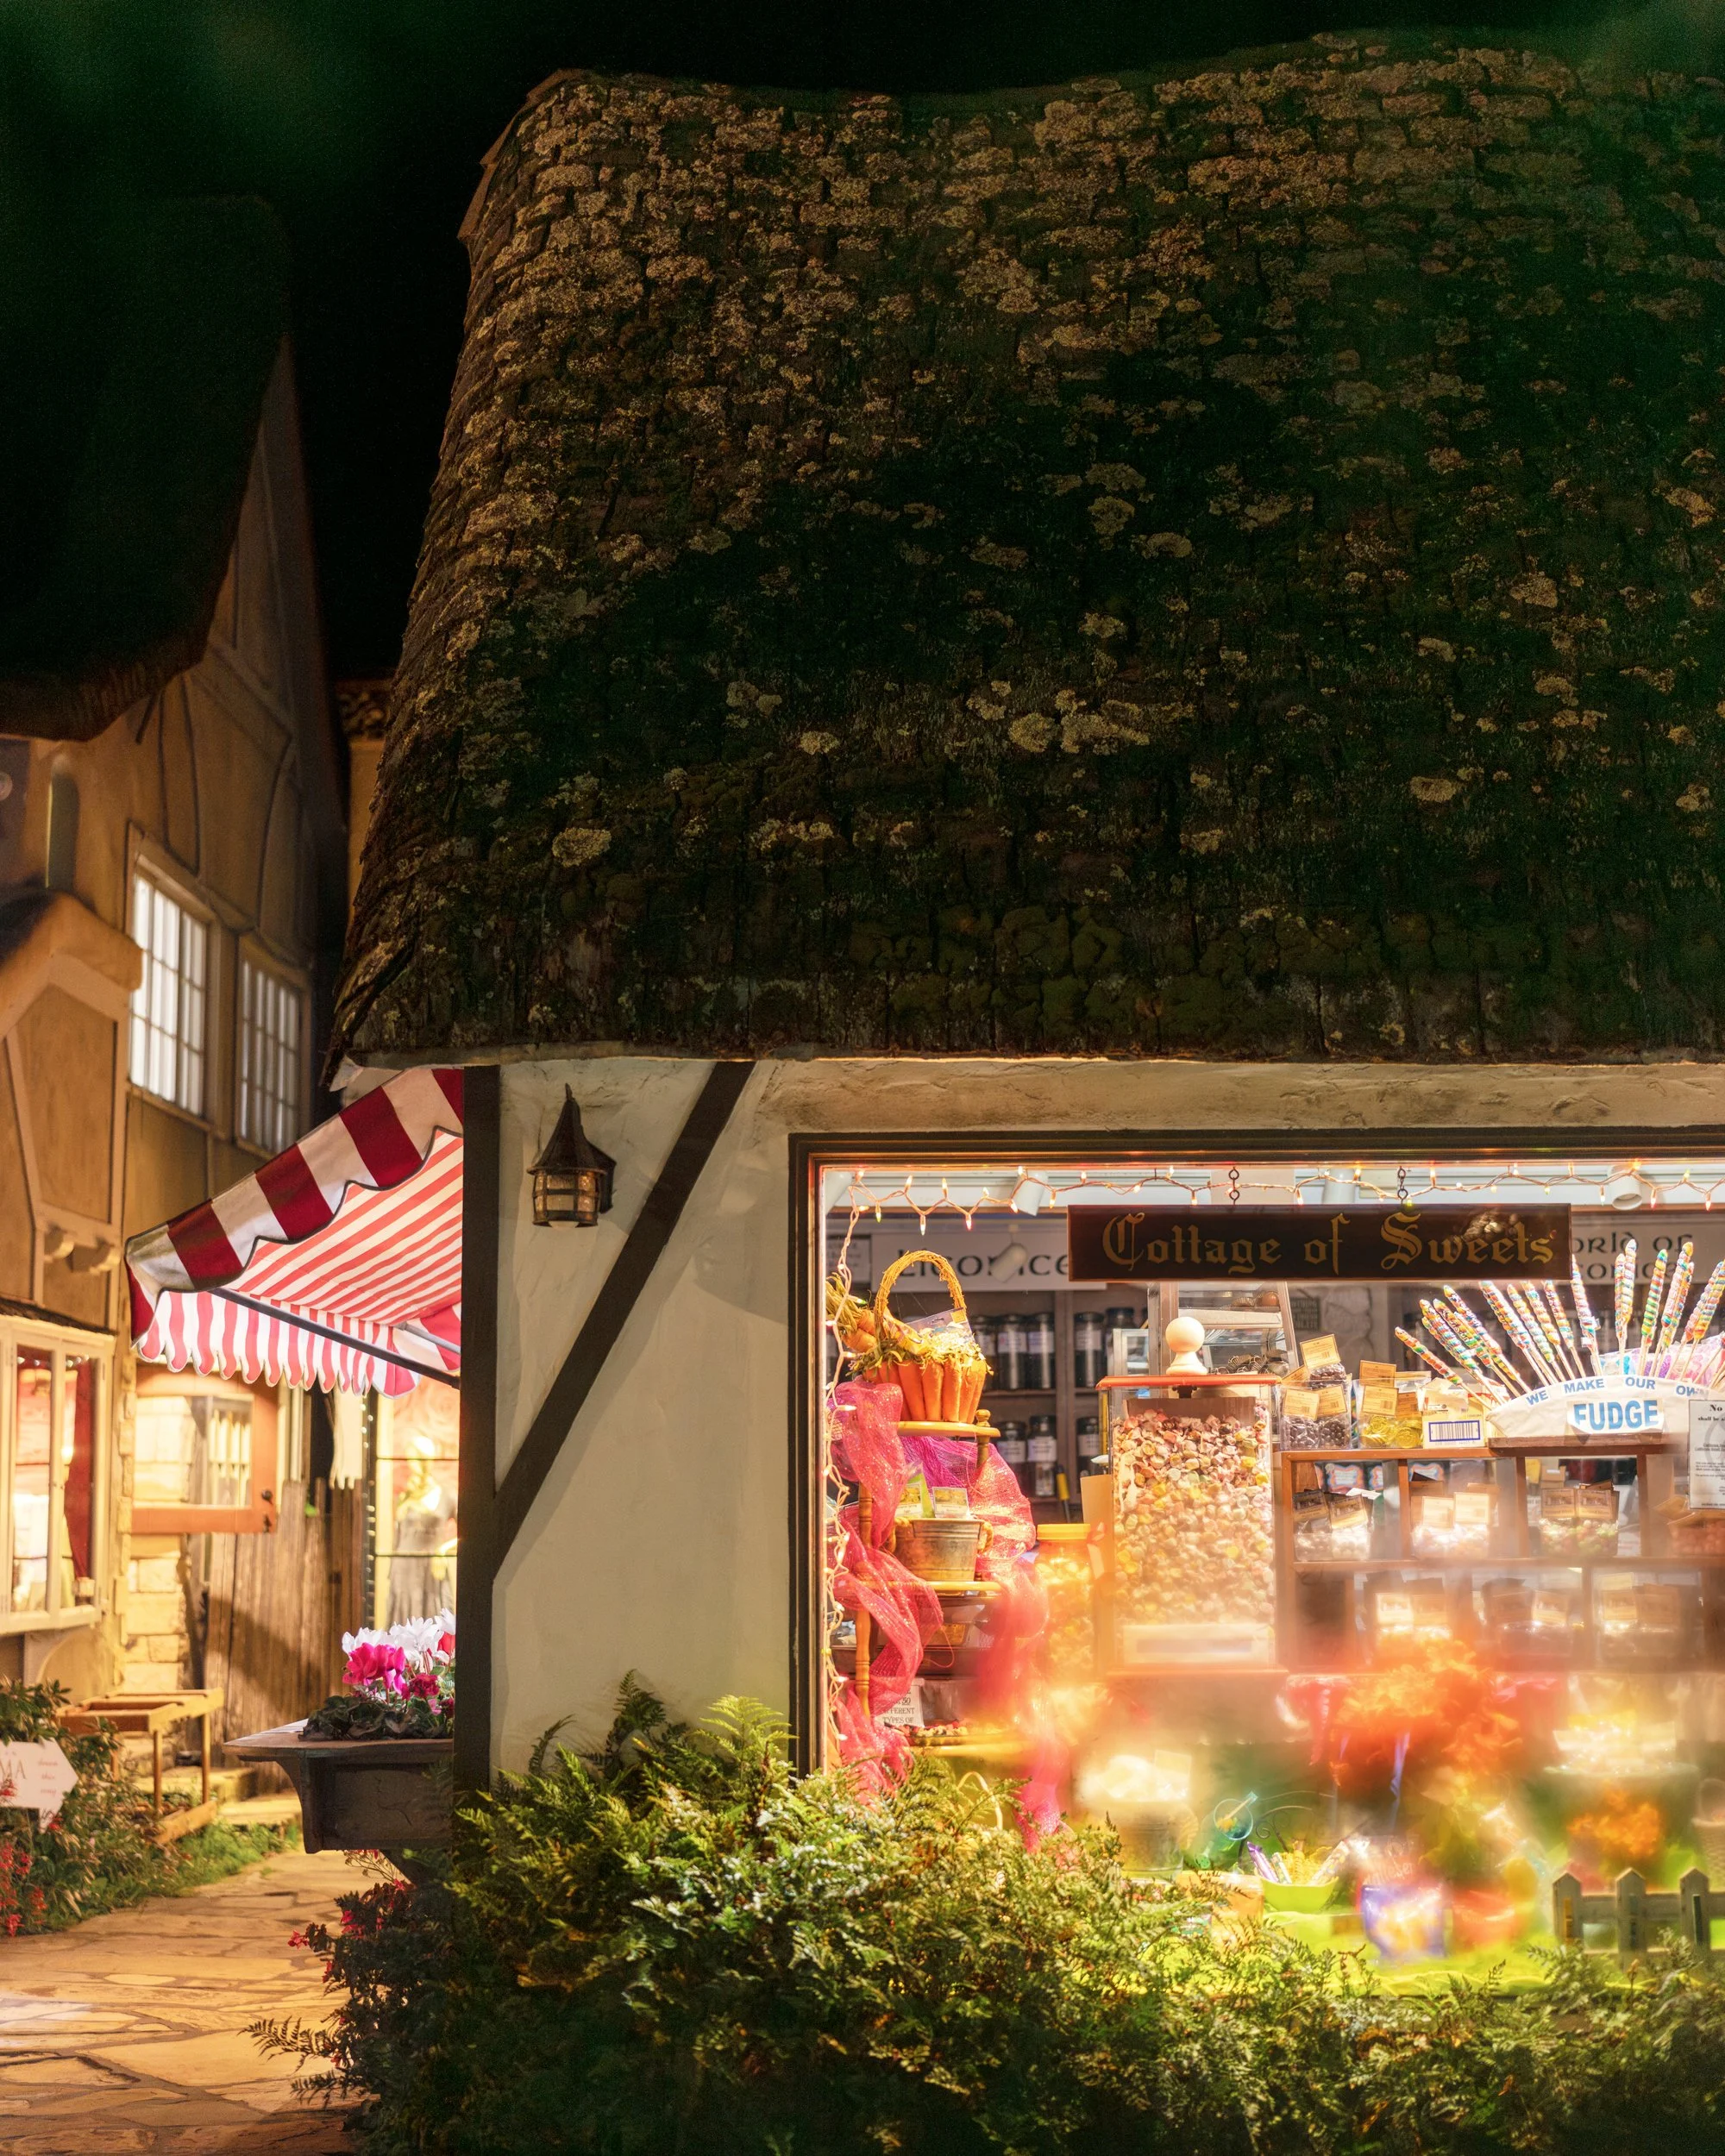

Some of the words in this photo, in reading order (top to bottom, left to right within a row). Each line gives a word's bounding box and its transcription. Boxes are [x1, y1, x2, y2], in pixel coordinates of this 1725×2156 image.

[1102, 1212, 1282, 1275] Cottage
[1304, 1212, 1351, 1275] of
[1380, 1211, 1555, 1270] Sweets
[1526, 1390, 1549, 1406] WE
[1565, 1378, 1605, 1395] MAKE
[1625, 1376, 1656, 1390] OUR
[1676, 1385, 1697, 1397] OW
[1573, 1399, 1659, 1431] FUDGE
